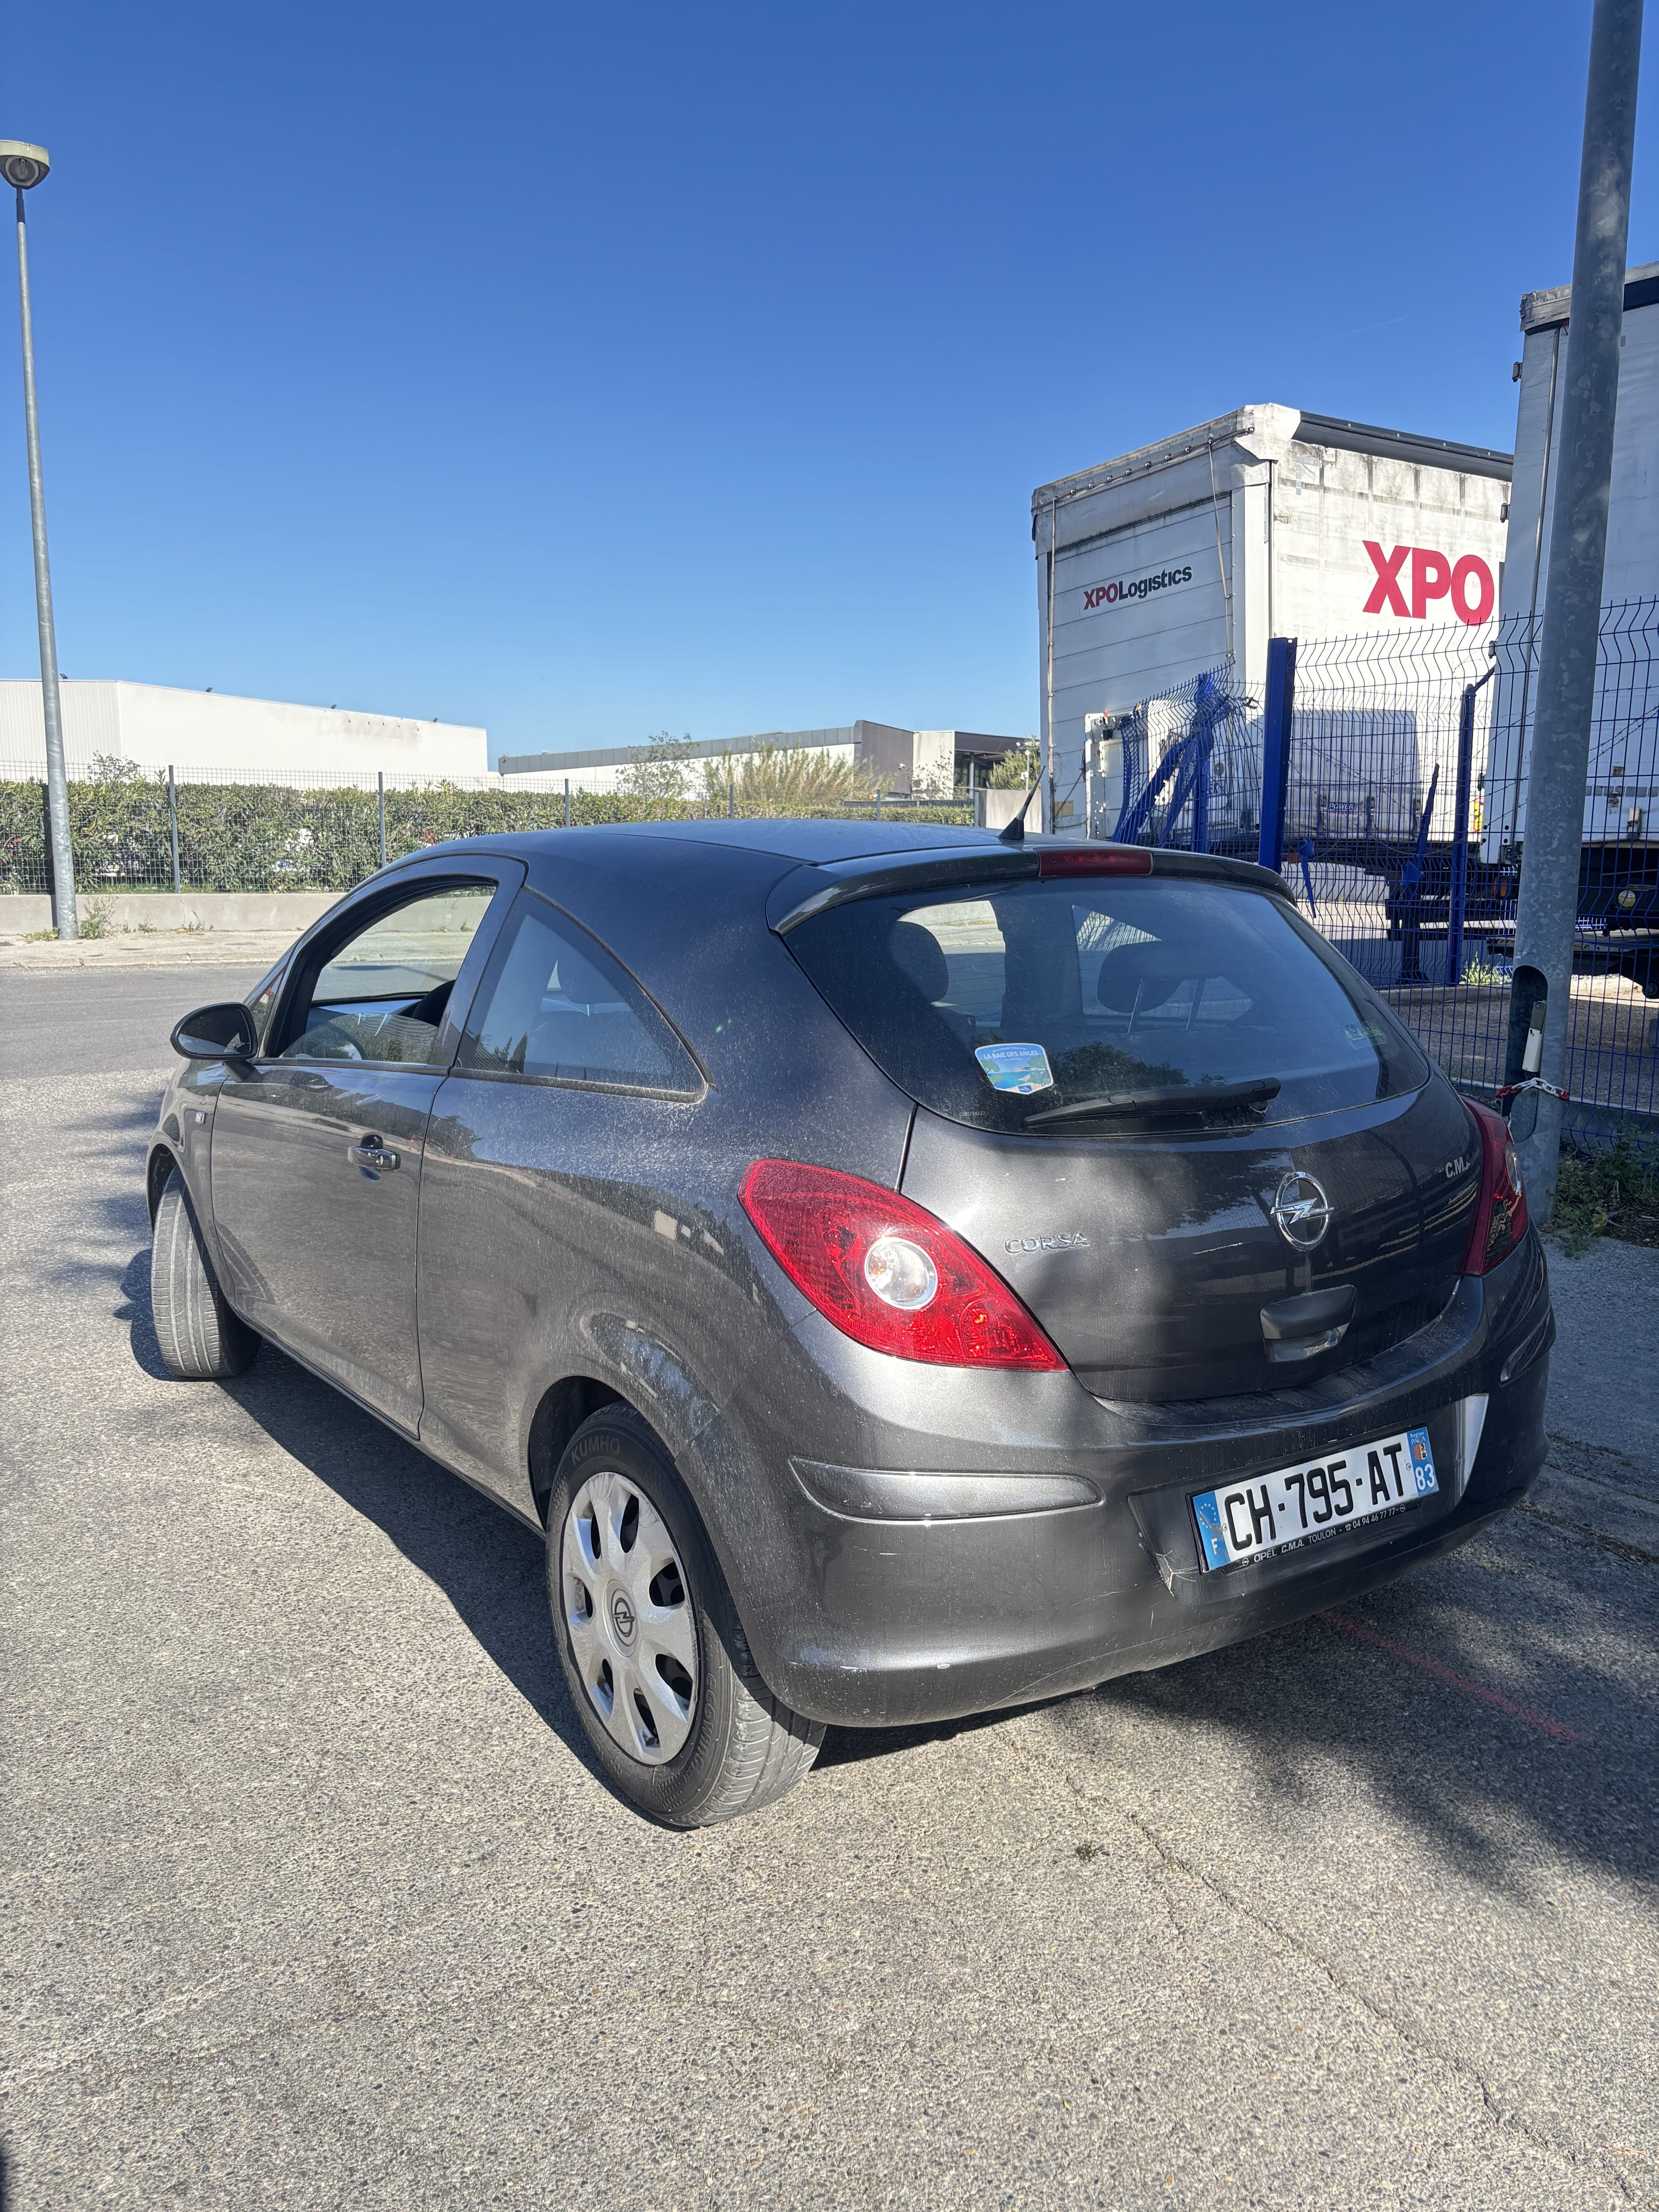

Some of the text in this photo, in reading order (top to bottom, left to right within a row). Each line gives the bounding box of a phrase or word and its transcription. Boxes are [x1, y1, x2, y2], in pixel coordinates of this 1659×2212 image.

[1362, 540, 1494, 627] XPO
[1005, 1231, 1090, 1254] CORSA
[571, 1435, 621, 1466] KUMHO
[1411, 1436, 1426, 1445] PACA
[1415, 1463, 1435, 1490] 83
[1211, 1537, 1218, 1555] F
[1254, 1549, 1277, 1563] OPEL
[1308, 1528, 1336, 1544] TOULON
[1353, 1519, 1360, 1528] 04
[1362, 1516, 1369, 1525] 94
[1371, 1513, 1378, 1522] 46
[1380, 1510, 1386, 1520] 77
[1388, 1507, 1395, 1516] 77
